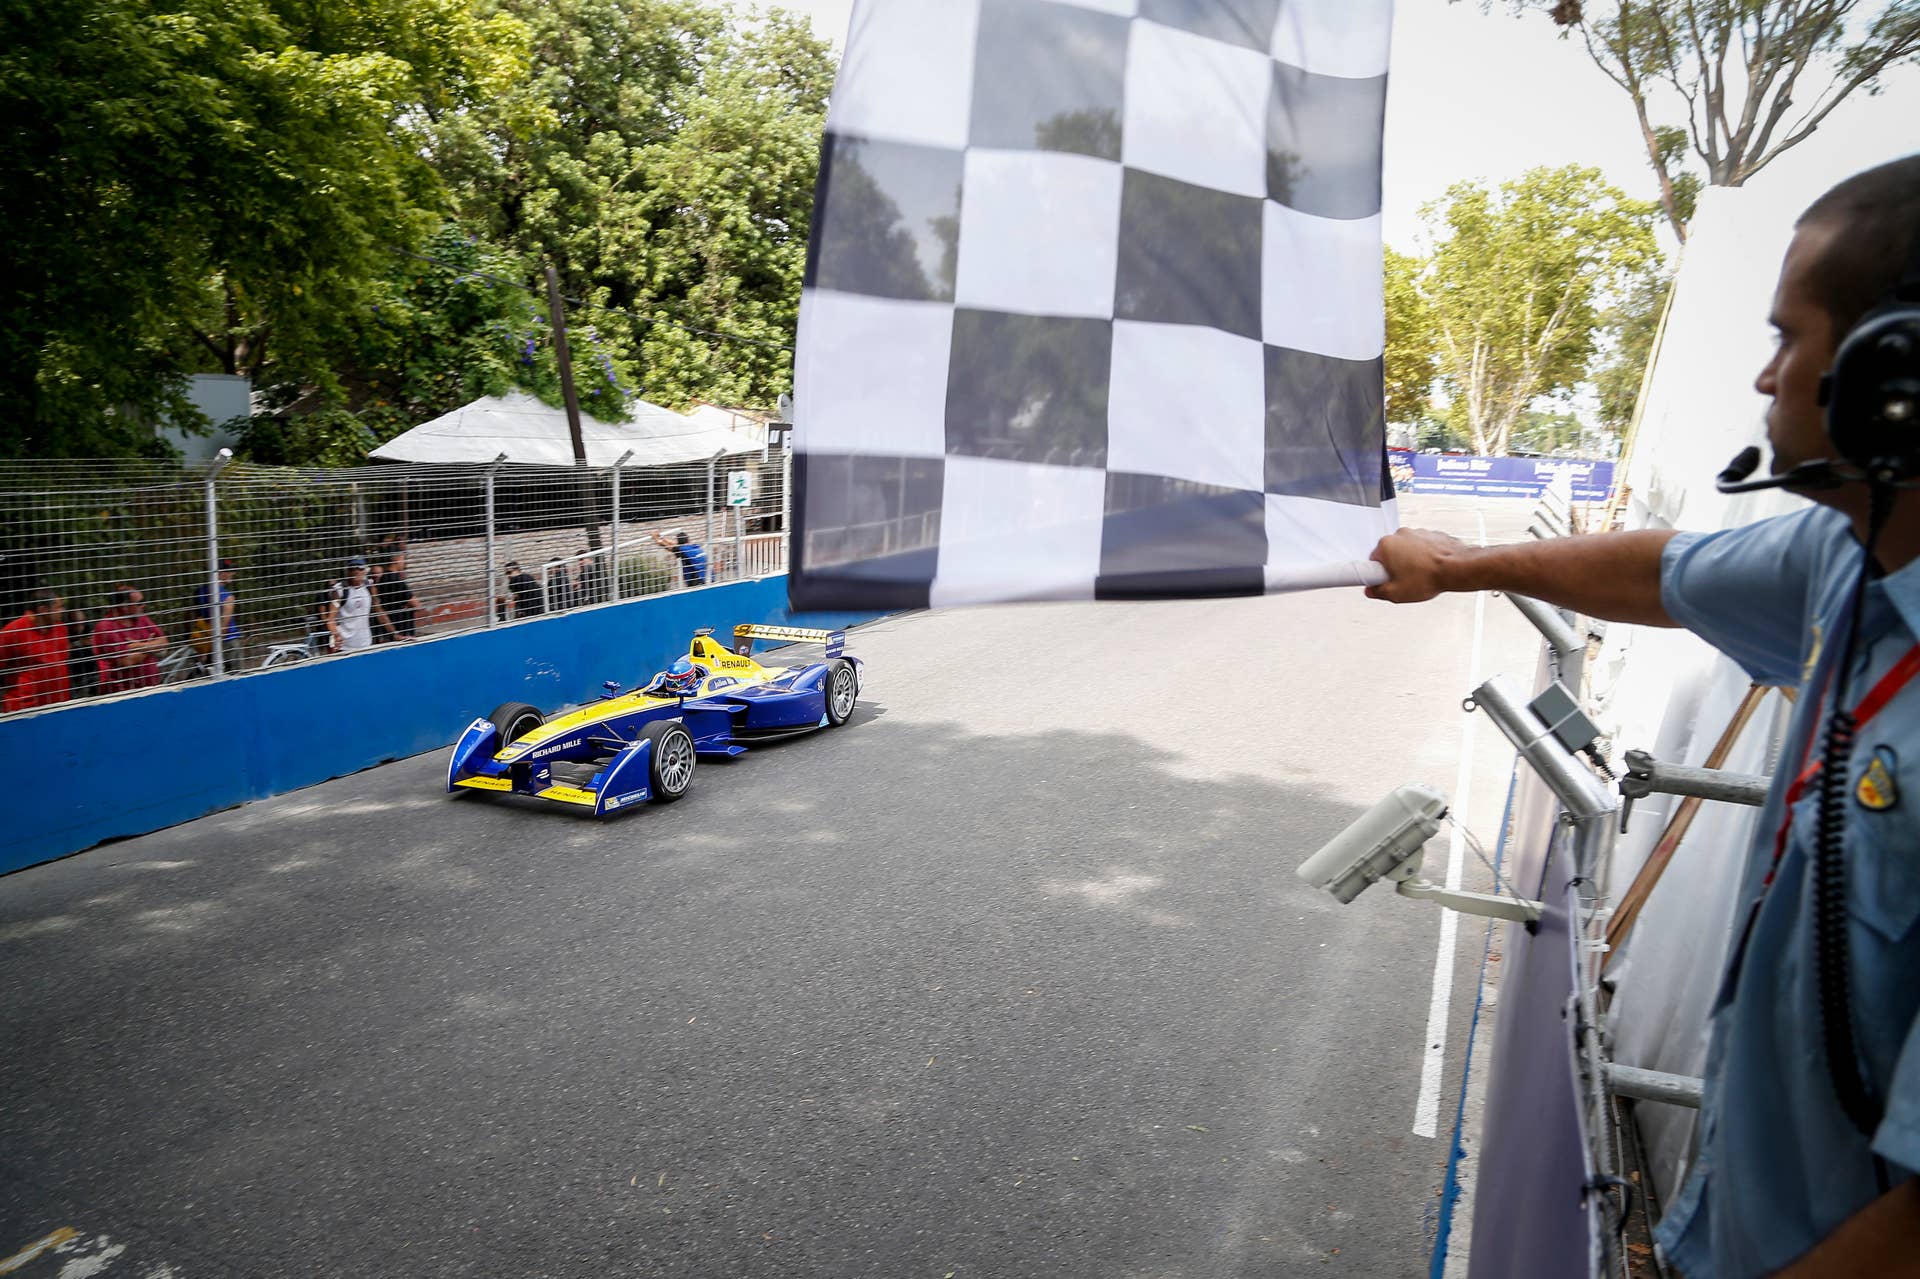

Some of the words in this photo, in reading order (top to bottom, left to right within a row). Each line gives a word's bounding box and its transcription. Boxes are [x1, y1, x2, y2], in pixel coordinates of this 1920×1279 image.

[721, 659, 751, 669] RENAULT
[532, 744, 562, 759] RICHARD
[562, 738, 582, 750] MILLE
